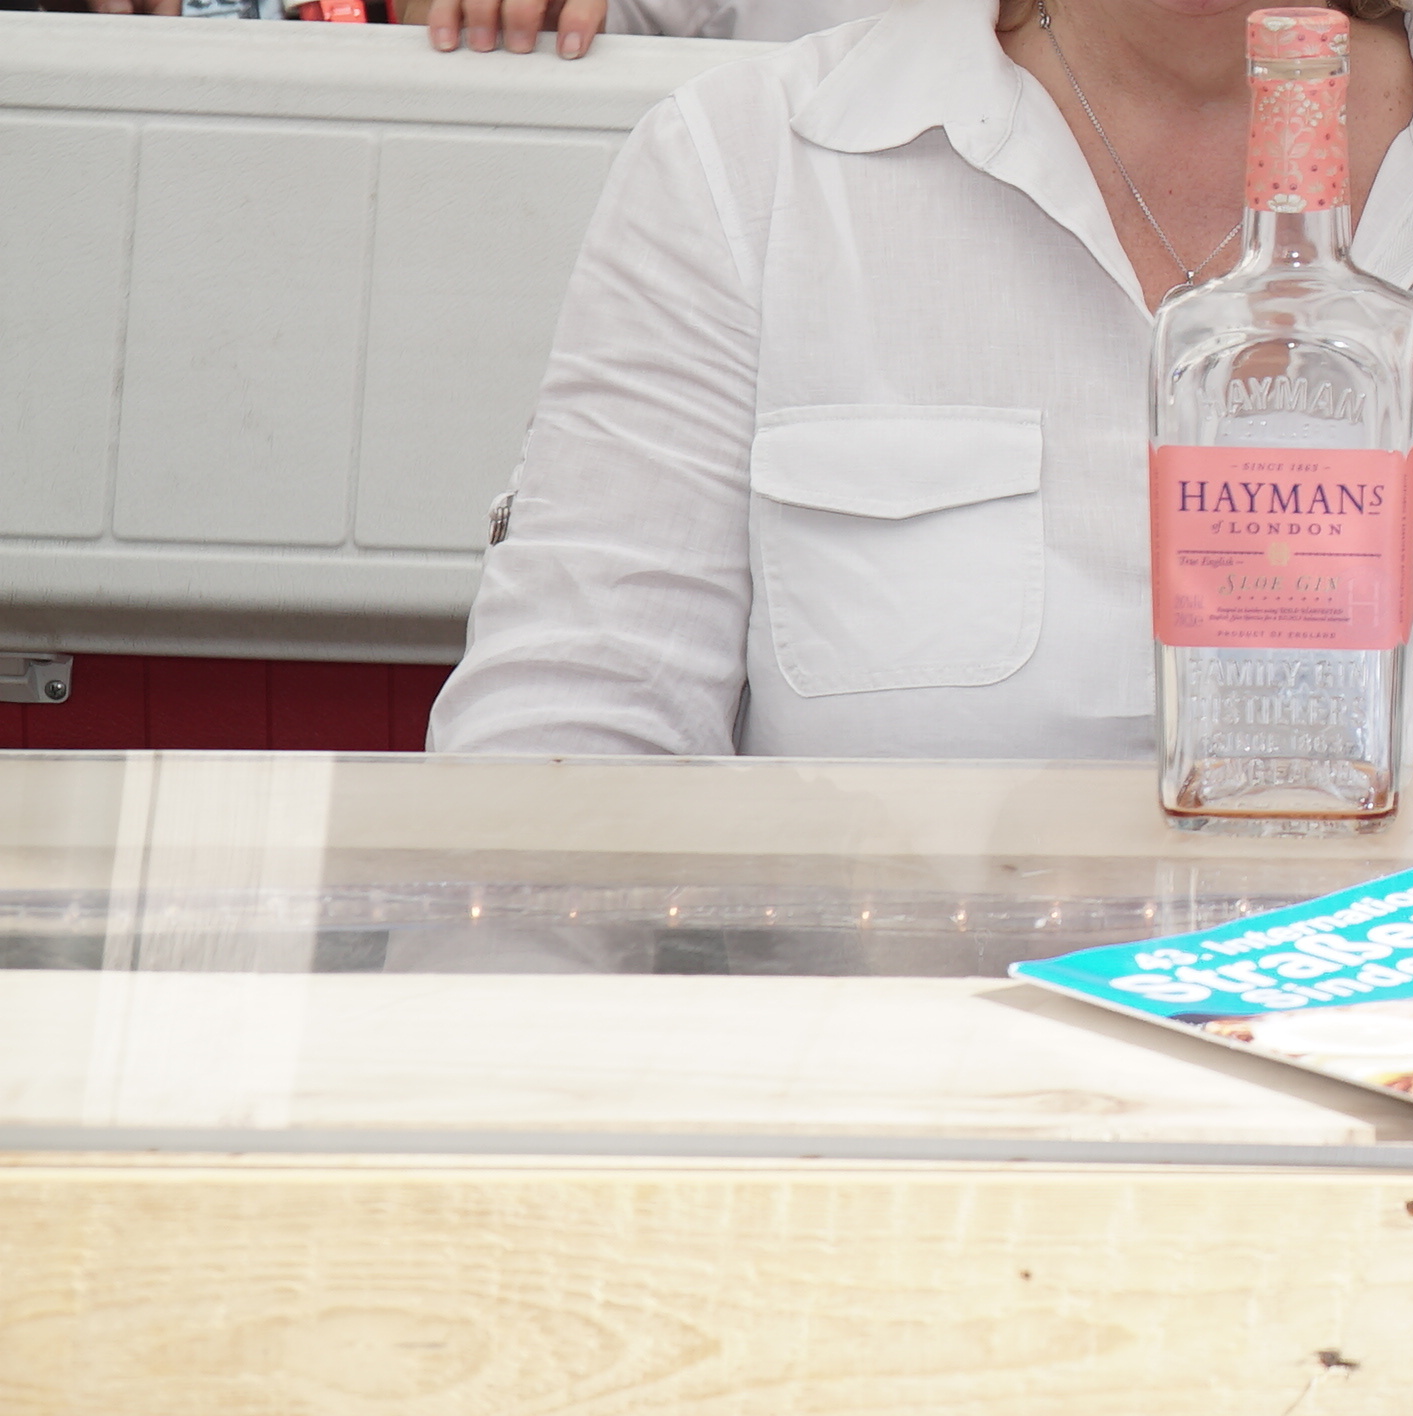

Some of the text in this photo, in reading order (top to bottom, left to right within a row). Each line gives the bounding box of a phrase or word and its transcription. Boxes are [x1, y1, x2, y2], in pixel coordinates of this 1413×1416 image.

[1177, 480, 1385, 516] HAYMANS
[1230, 521, 1343, 536] LONDON
[1296, 574, 1341, 592] GIN
